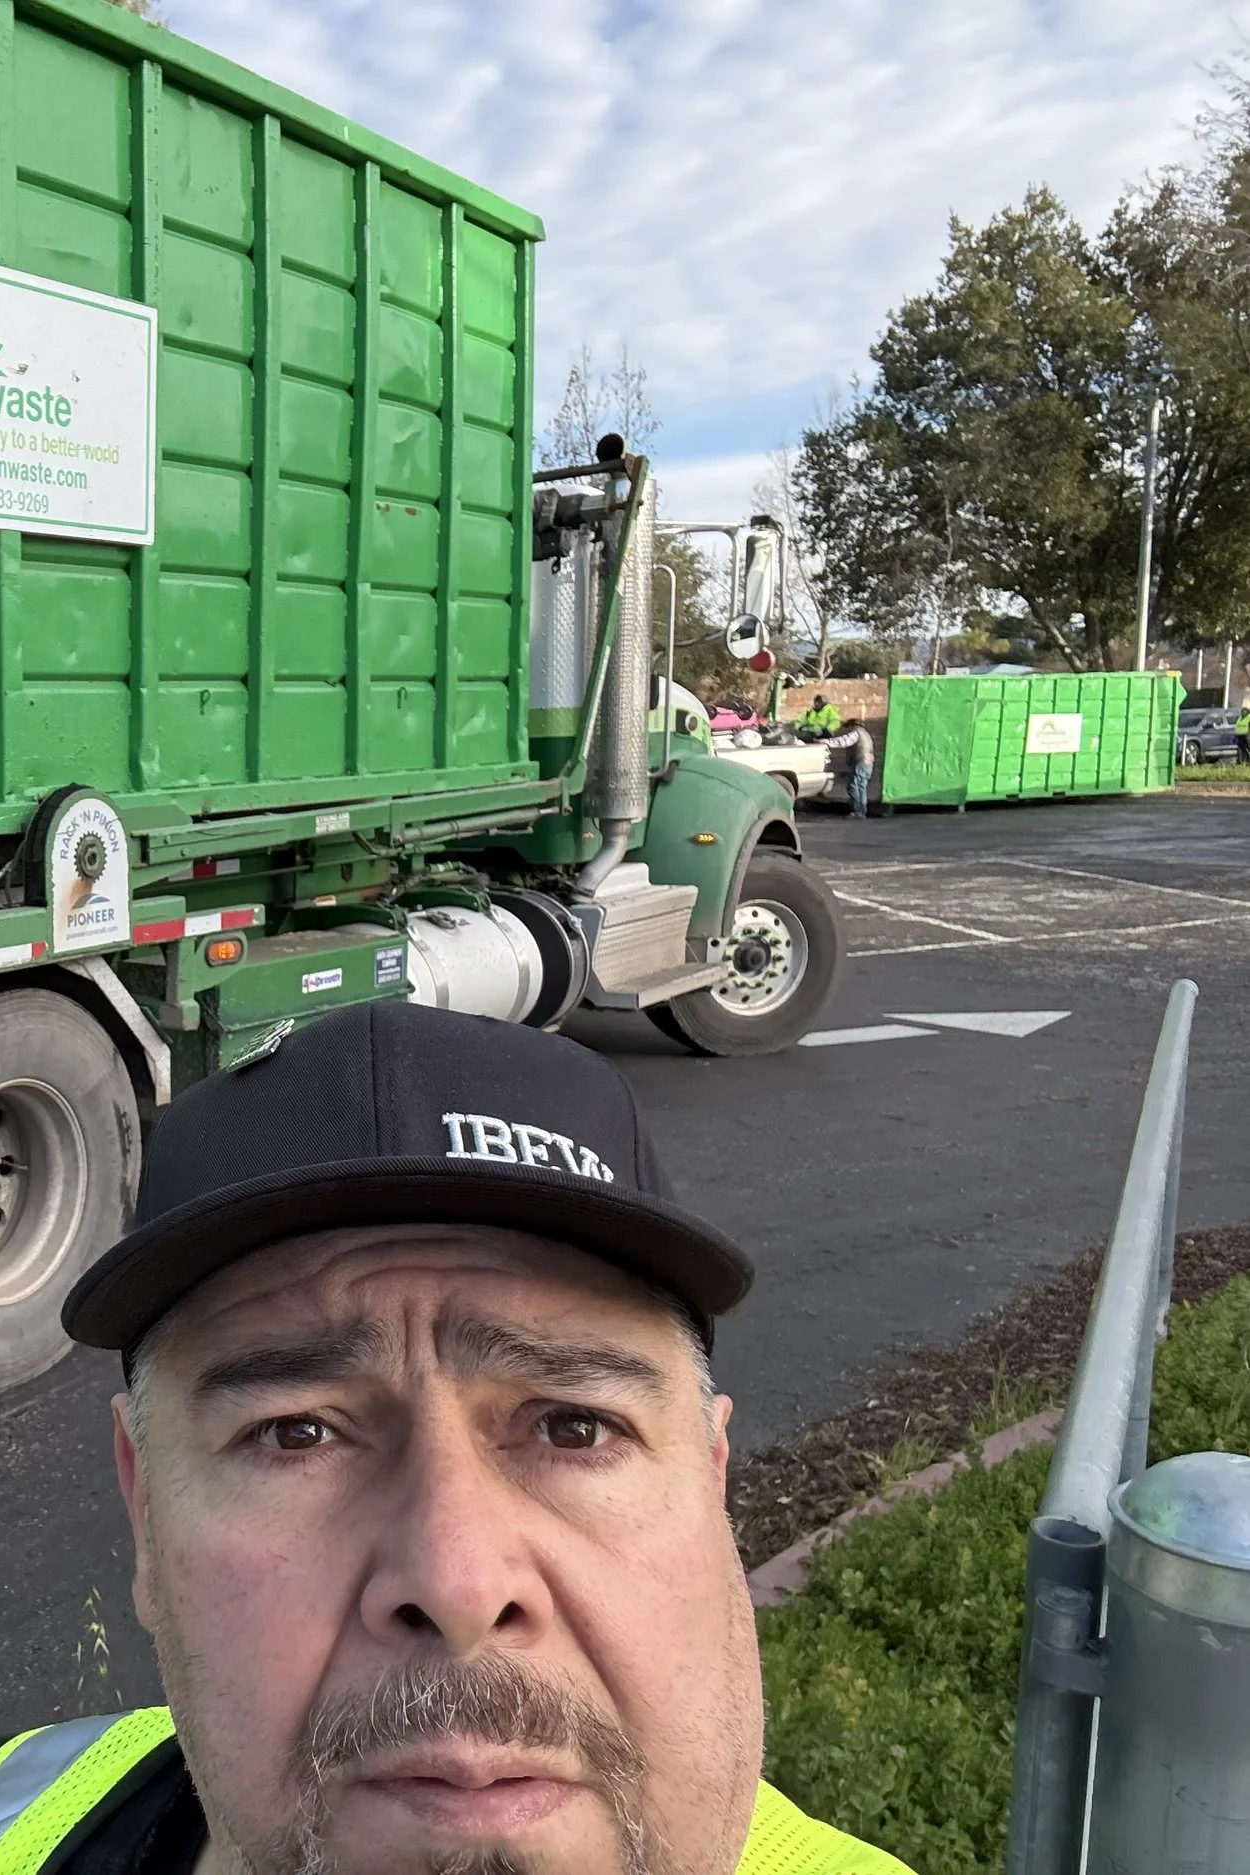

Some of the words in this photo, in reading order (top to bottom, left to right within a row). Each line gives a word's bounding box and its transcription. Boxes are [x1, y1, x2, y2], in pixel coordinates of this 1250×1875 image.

[11, 428, 26, 449] to
[29, 435, 38, 450] a
[41, 431, 80, 458] better
[83, 444, 120, 464] world
[60, 817, 80, 860] RACK
[93, 810, 120, 853] PINION
[67, 908, 115, 928] PIONEER
